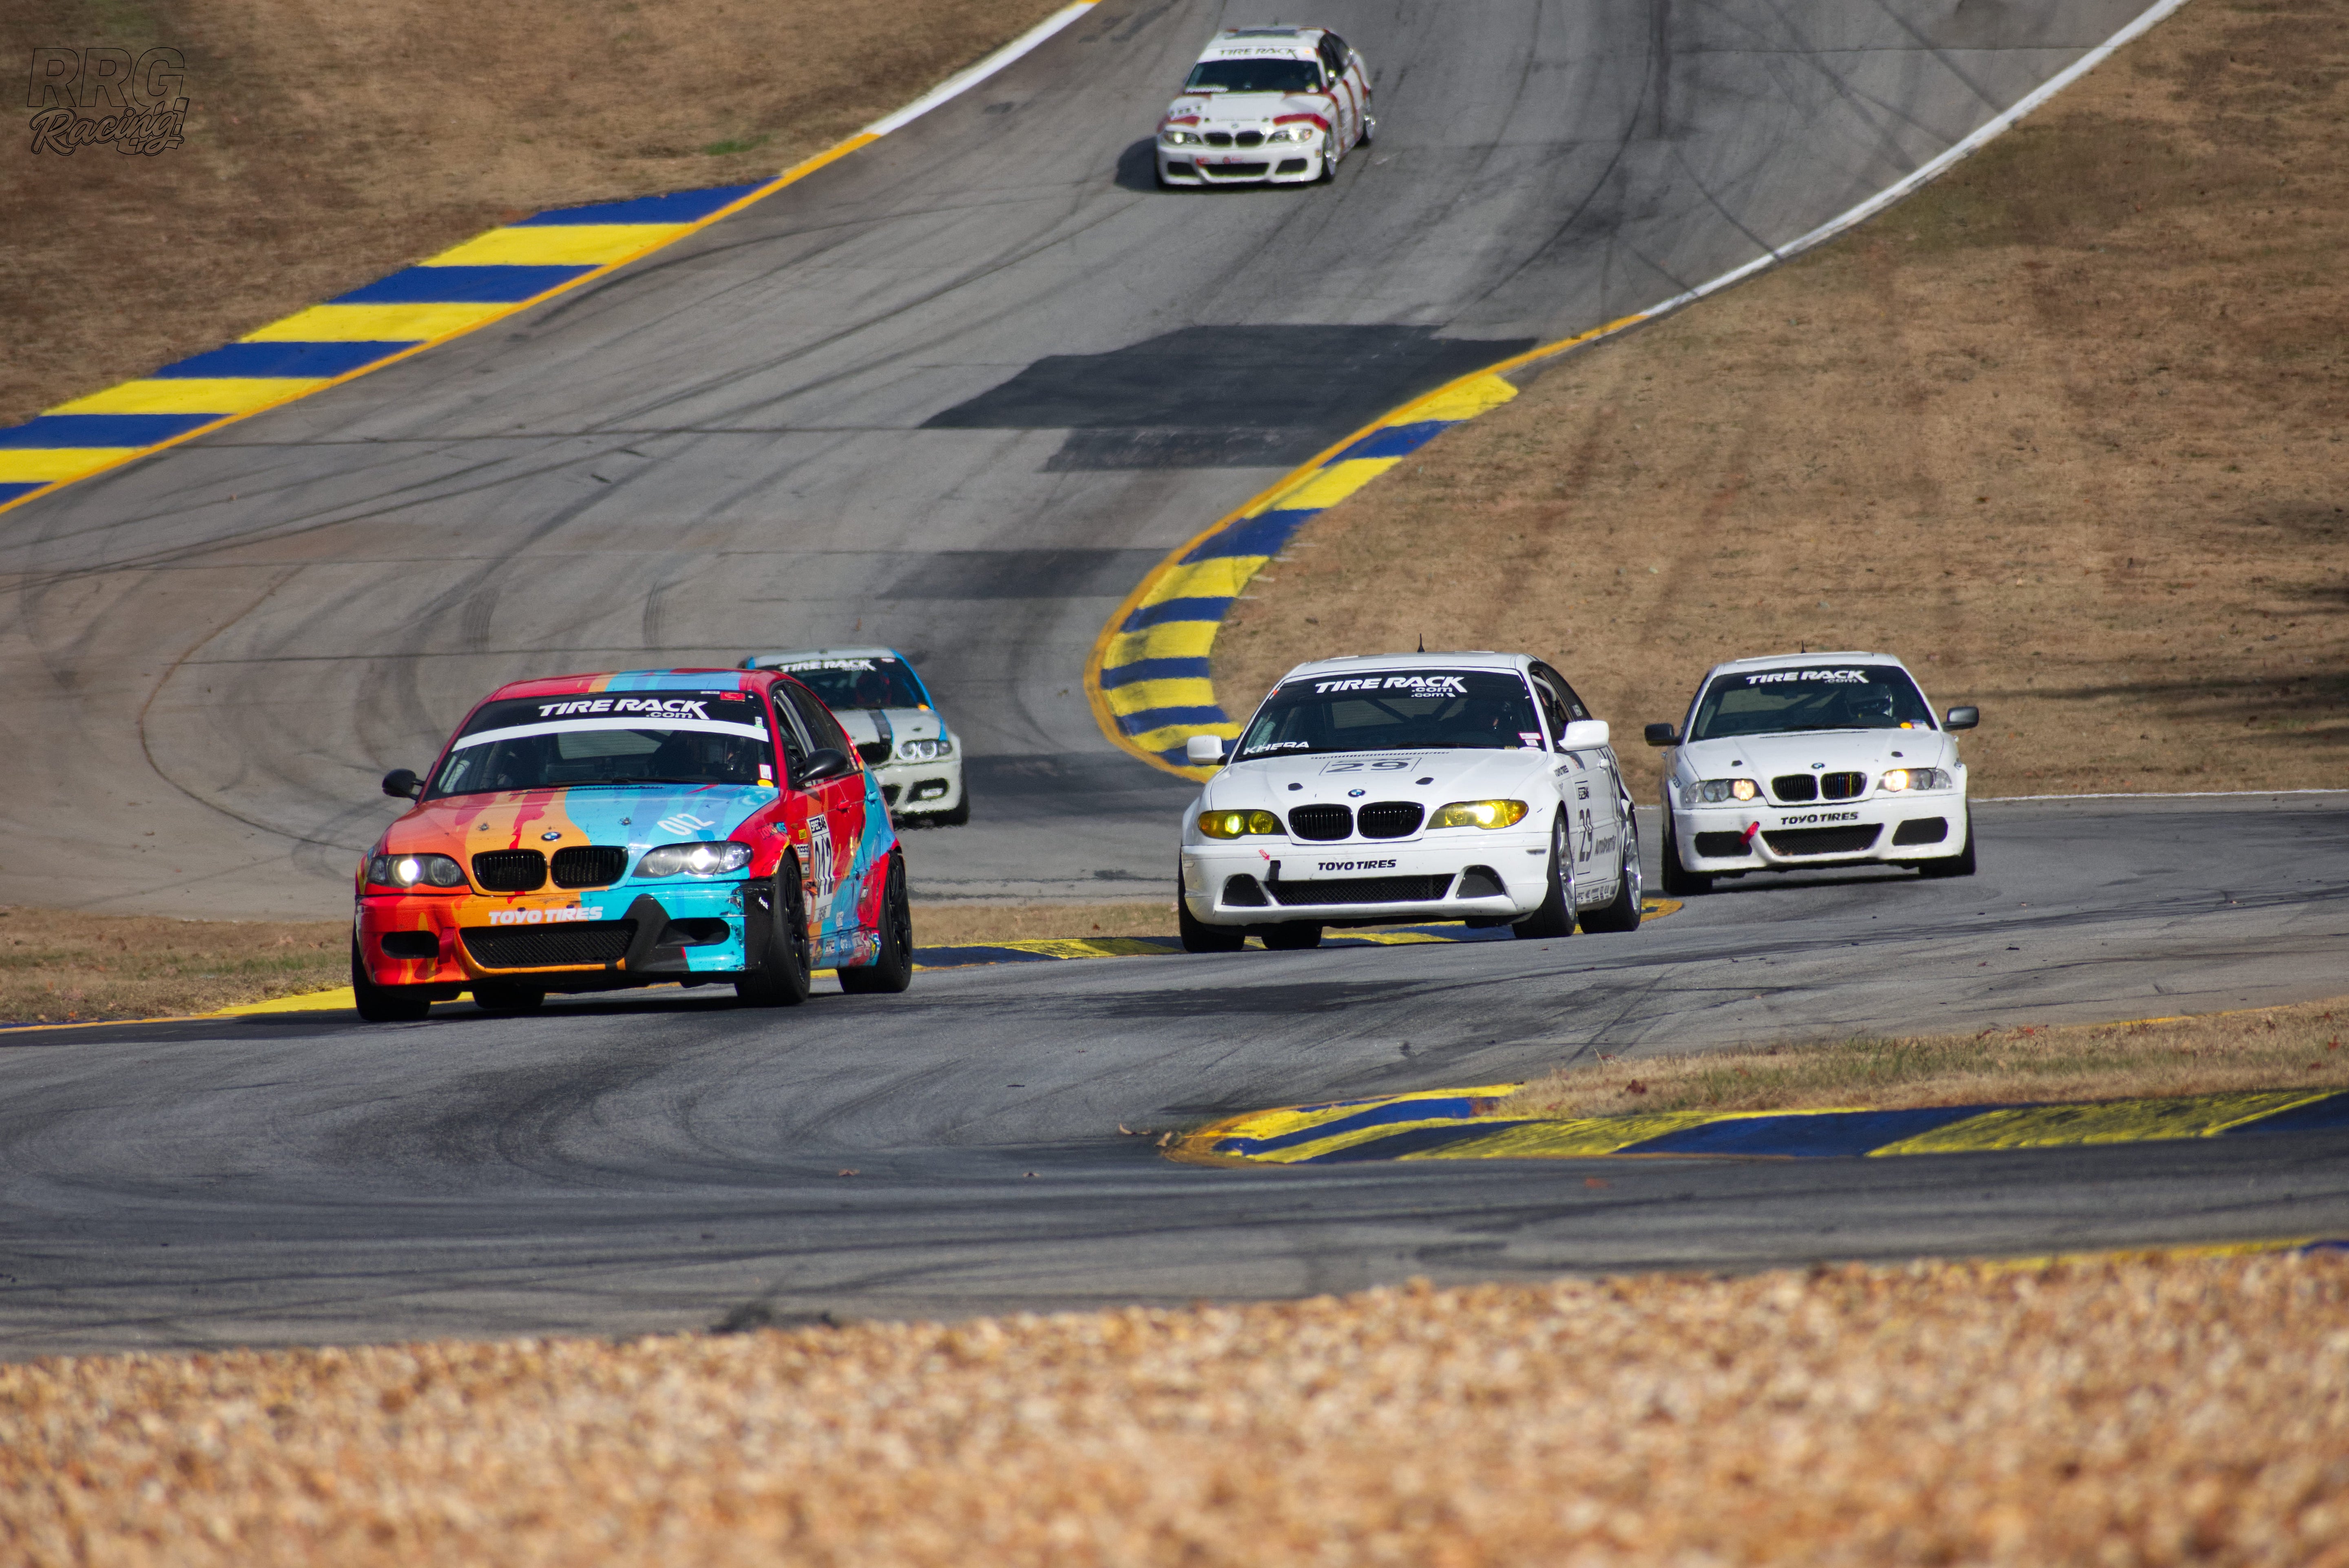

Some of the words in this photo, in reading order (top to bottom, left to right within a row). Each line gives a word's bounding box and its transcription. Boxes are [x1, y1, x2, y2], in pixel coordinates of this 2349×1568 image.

[1255, 48, 1298, 60] RACK
[779, 660, 821, 672] TIRE
[823, 659, 876, 671] RACK
[1315, 678, 1382, 693] TIRE
[1383, 676, 1468, 693] RACK
[1746, 672, 1799, 685] TIRE
[1800, 670, 1869, 684] RACK
[538, 699, 614, 717] TIRE
[613, 699, 710, 720] RACK
[646, 711, 693, 719] .com
[1243, 741, 1309, 755] KHERA
[1325, 761, 1409, 773] 29
[657, 813, 716, 836] 012
[1781, 814, 1818, 825] TOYO
[1819, 812, 1859, 822] TIRES
[1579, 807, 1594, 863] 29
[815, 837, 834, 898] 012
[1318, 862, 1355, 871] TOYO
[1356, 859, 1397, 869] TIRES
[488, 910, 542, 925] TOYO
[544, 906, 604, 922] TIRES
